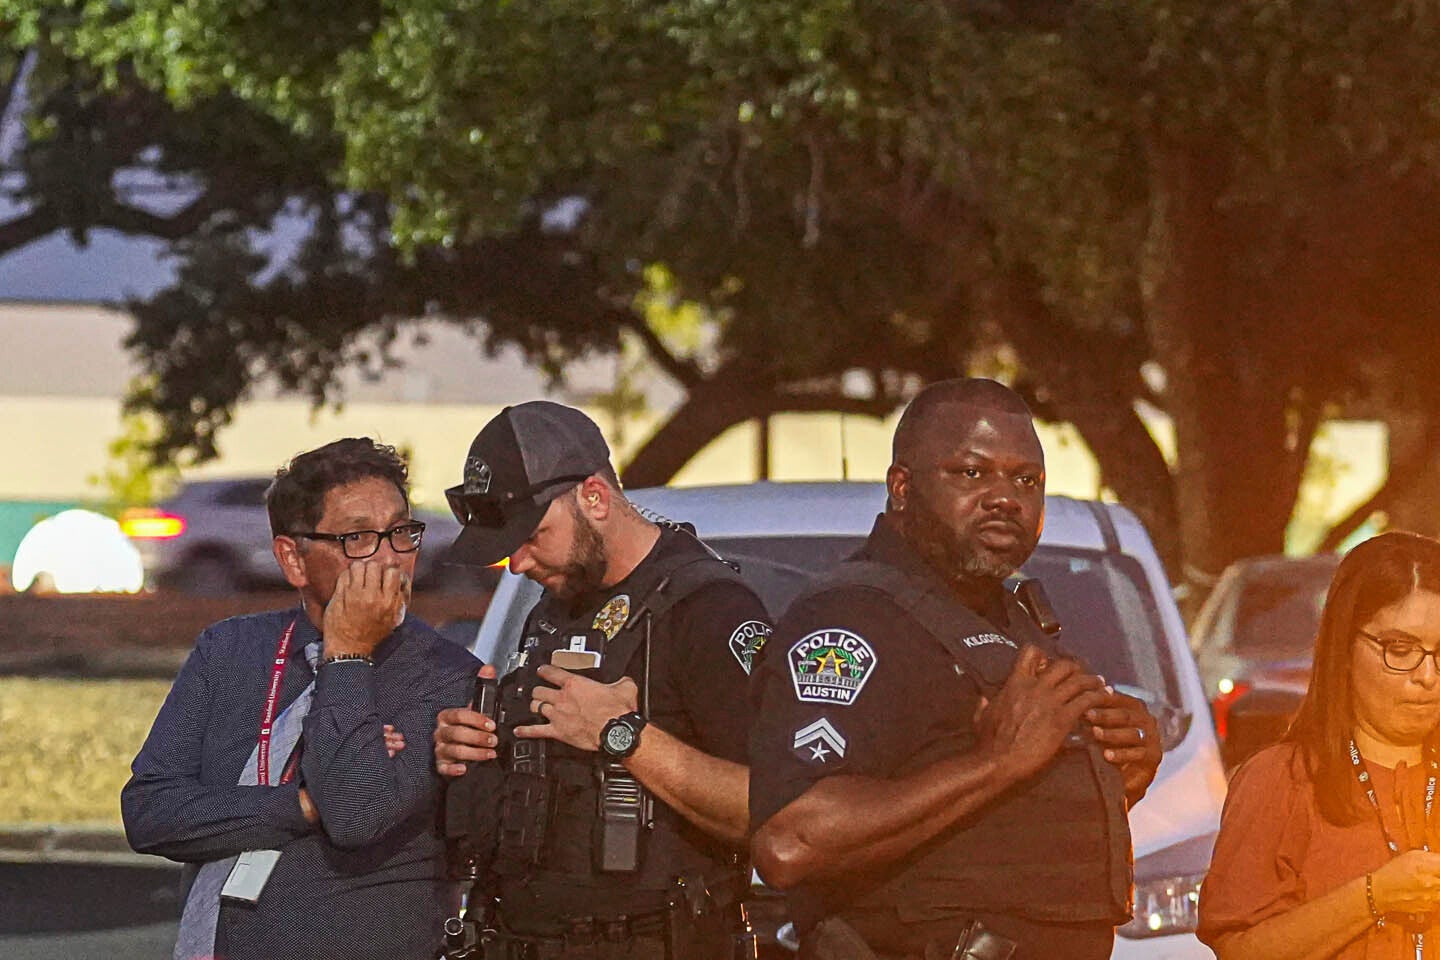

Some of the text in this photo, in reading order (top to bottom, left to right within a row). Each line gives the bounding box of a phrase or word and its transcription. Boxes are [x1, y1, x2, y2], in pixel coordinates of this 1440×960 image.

[796, 632, 870, 663] POLICE
[263, 670, 282, 724] Stanford University
[802, 685, 851, 700] AUSTIN
[1425, 776, 1437, 801] Police
